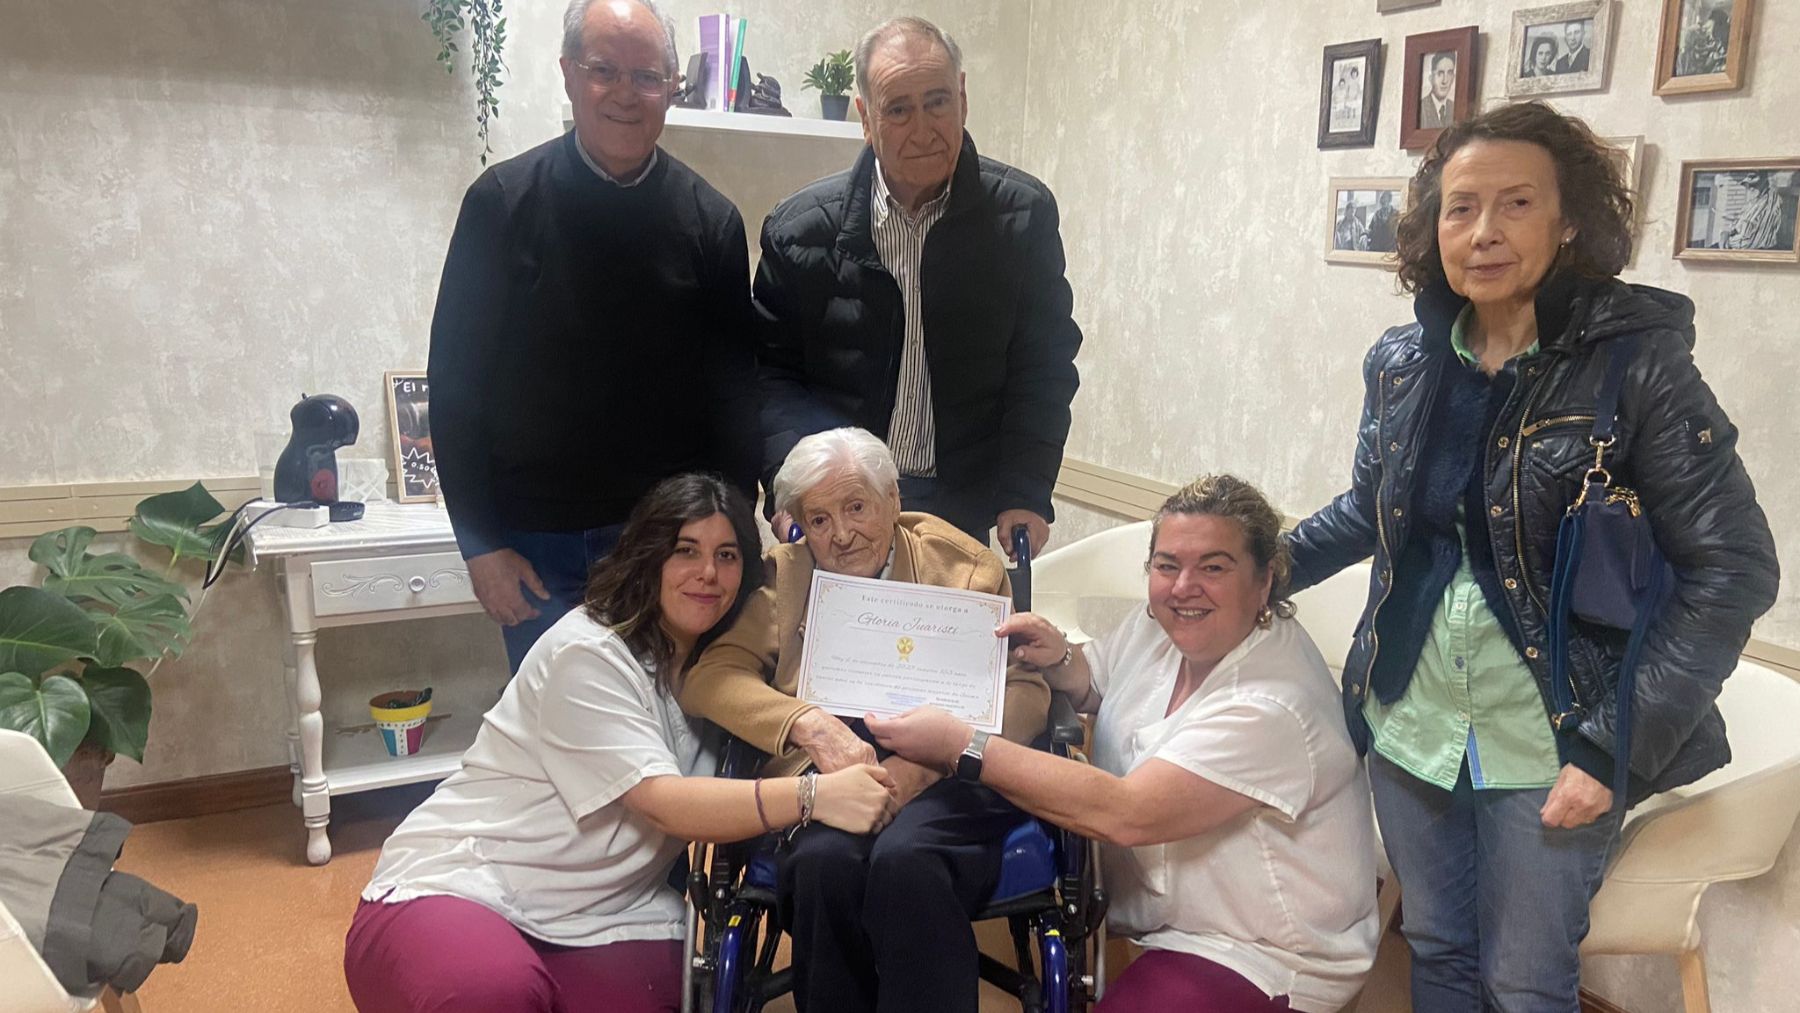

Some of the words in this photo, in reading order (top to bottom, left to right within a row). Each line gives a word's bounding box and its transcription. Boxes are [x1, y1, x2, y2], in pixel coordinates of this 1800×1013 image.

[403, 382, 416, 393] El
[857, 612, 900, 627] Gloria
[902, 616, 960, 635] Juaristi
